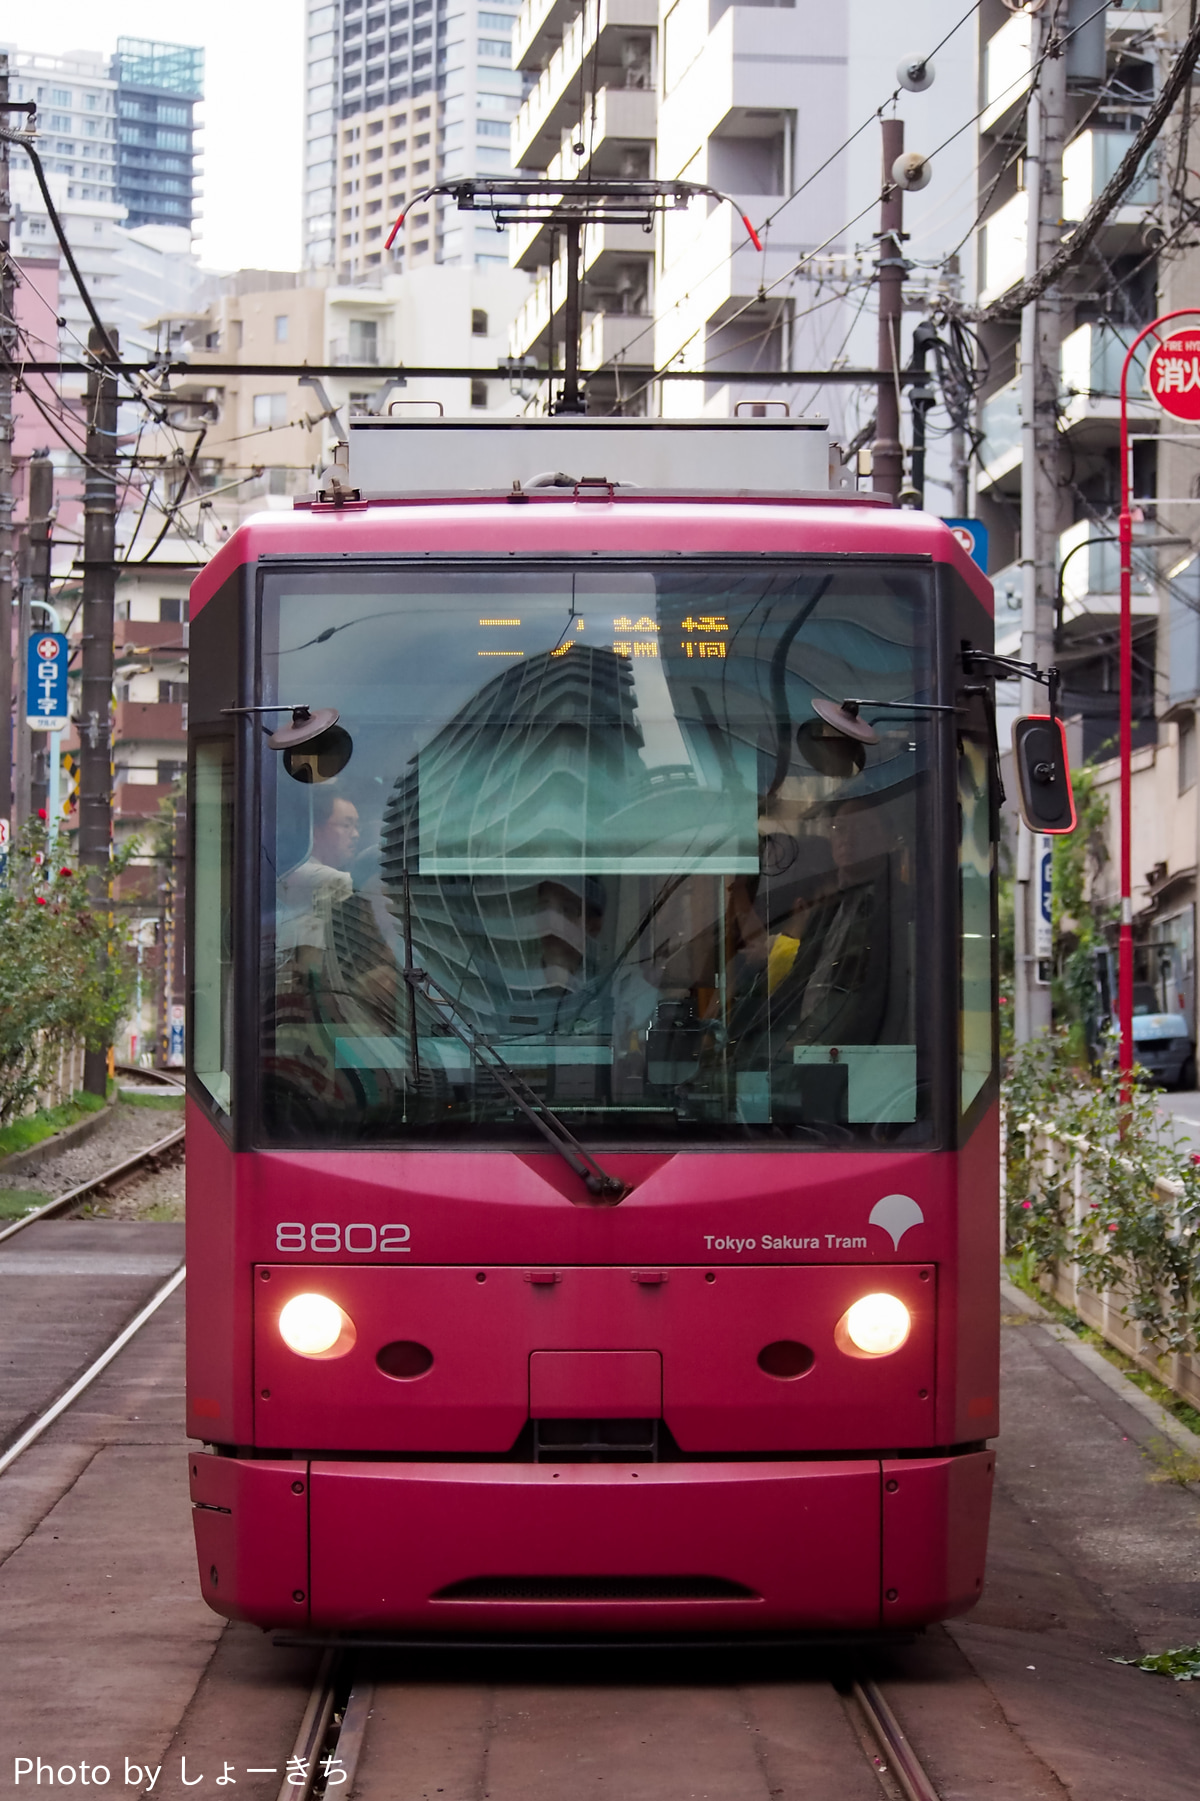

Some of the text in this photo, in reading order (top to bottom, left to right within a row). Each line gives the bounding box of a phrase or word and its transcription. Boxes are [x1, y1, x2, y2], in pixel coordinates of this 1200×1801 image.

[1163, 340, 1183, 352] FIRE
[37, 660, 58, 715] 白十字
[276, 1222, 411, 1254] 8802
[703, 1234, 867, 1253] Tokyo Sakura Tram
